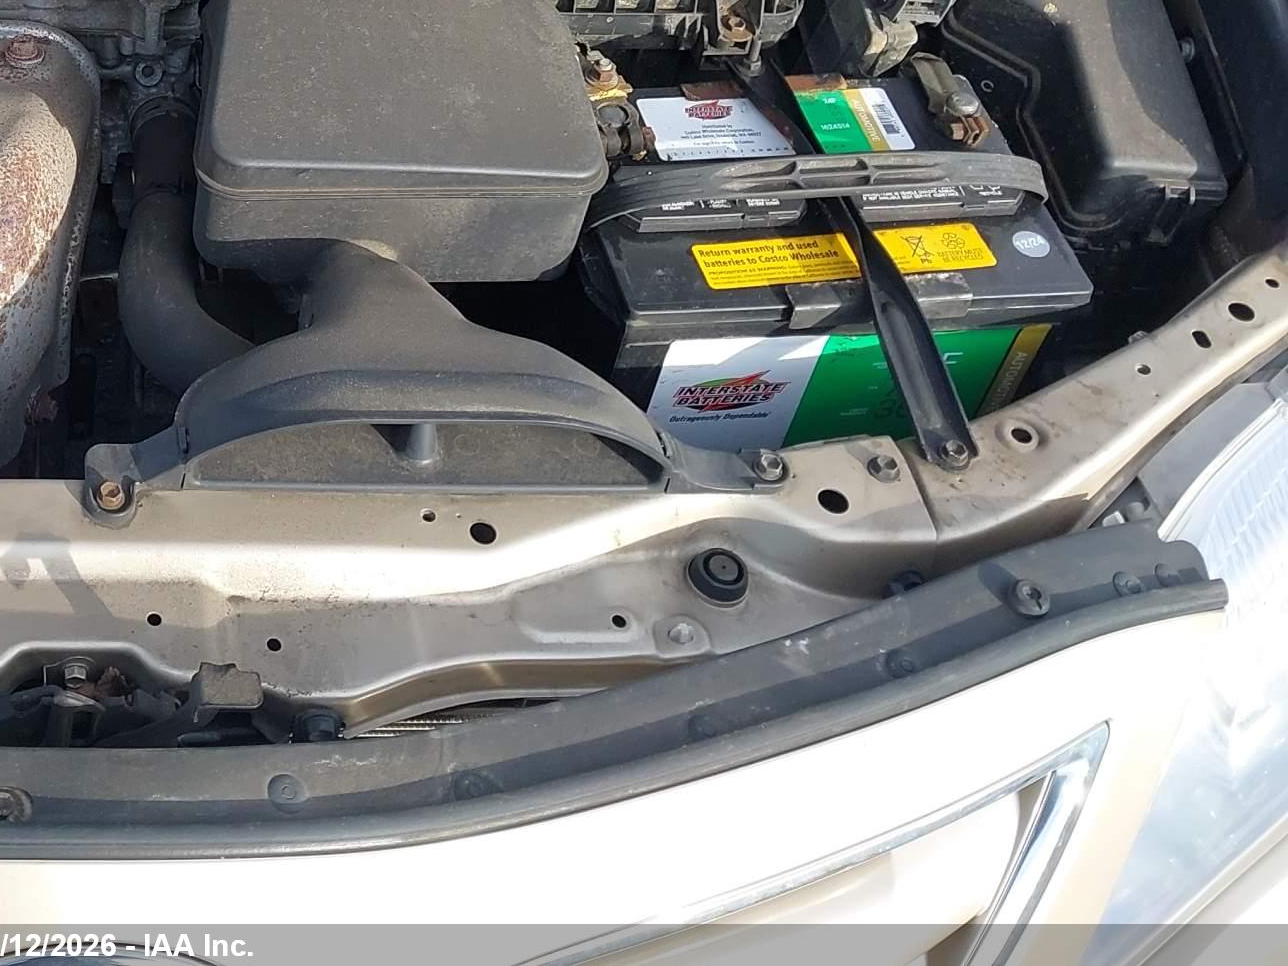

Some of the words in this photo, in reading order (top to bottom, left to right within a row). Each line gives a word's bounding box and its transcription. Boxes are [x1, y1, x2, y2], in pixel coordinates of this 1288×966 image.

[685, 105, 733, 114] INTERSTATE
[688, 110, 732, 118] BATTERIES
[852, 99, 881, 142] AUTOMOTIVE
[698, 247, 731, 258] Return
[732, 244, 775, 256] warranty
[777, 243, 794, 252] and
[796, 240, 819, 250] used
[1015, 236, 1045, 250] 12/24
[703, 257, 746, 268] batteries
[747, 255, 757, 265] to
[758, 254, 789, 263] Costco
[789, 249, 840, 262] Wholesale
[675, 383, 785, 398] INTERSTATE
[675, 392, 772, 407] BATTERIES
[669, 413, 722, 423] Outrageously
[723, 411, 769, 421] Dependable
